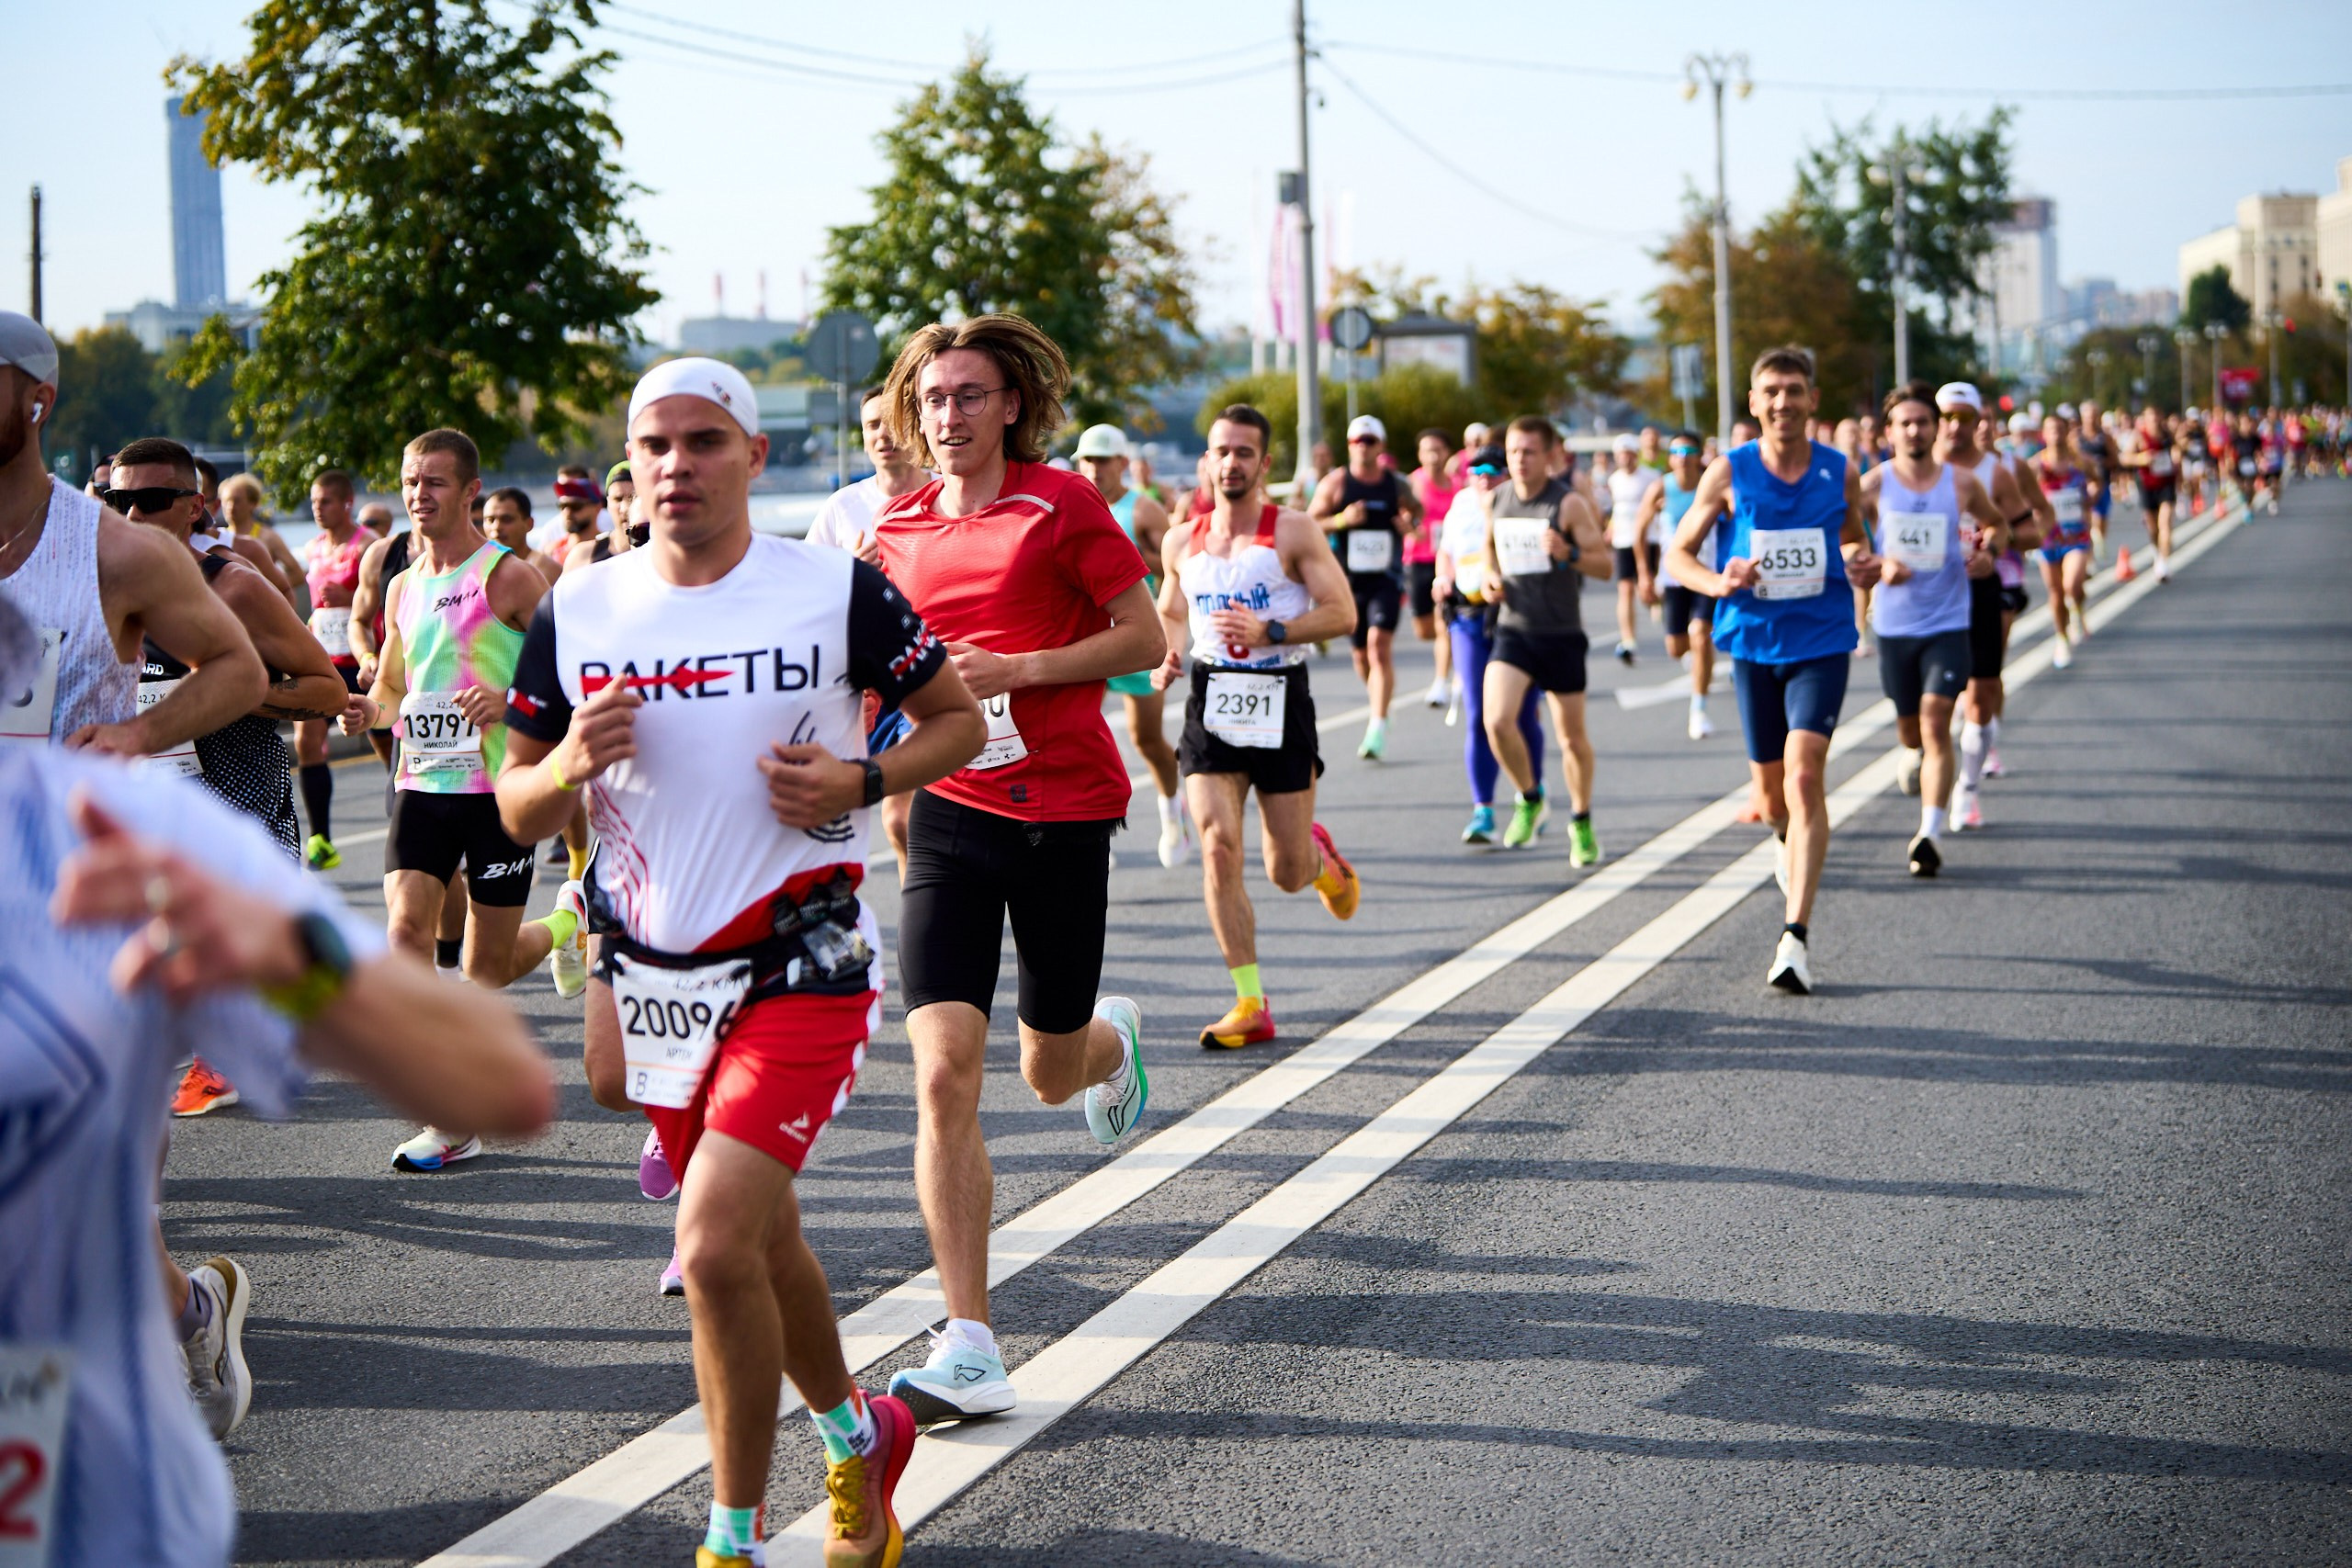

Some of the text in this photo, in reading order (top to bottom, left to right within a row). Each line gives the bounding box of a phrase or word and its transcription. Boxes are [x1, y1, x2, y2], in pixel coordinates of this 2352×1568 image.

[1898, 528, 1931, 547] 441
[1762, 548, 1815, 570] 6533
[580, 644, 820, 703] РАКЕТЫ
[1216, 693, 1270, 716] 2391
[424, 739, 458, 750] НИКОЛАЙ
[622, 995, 736, 1042] 20096
